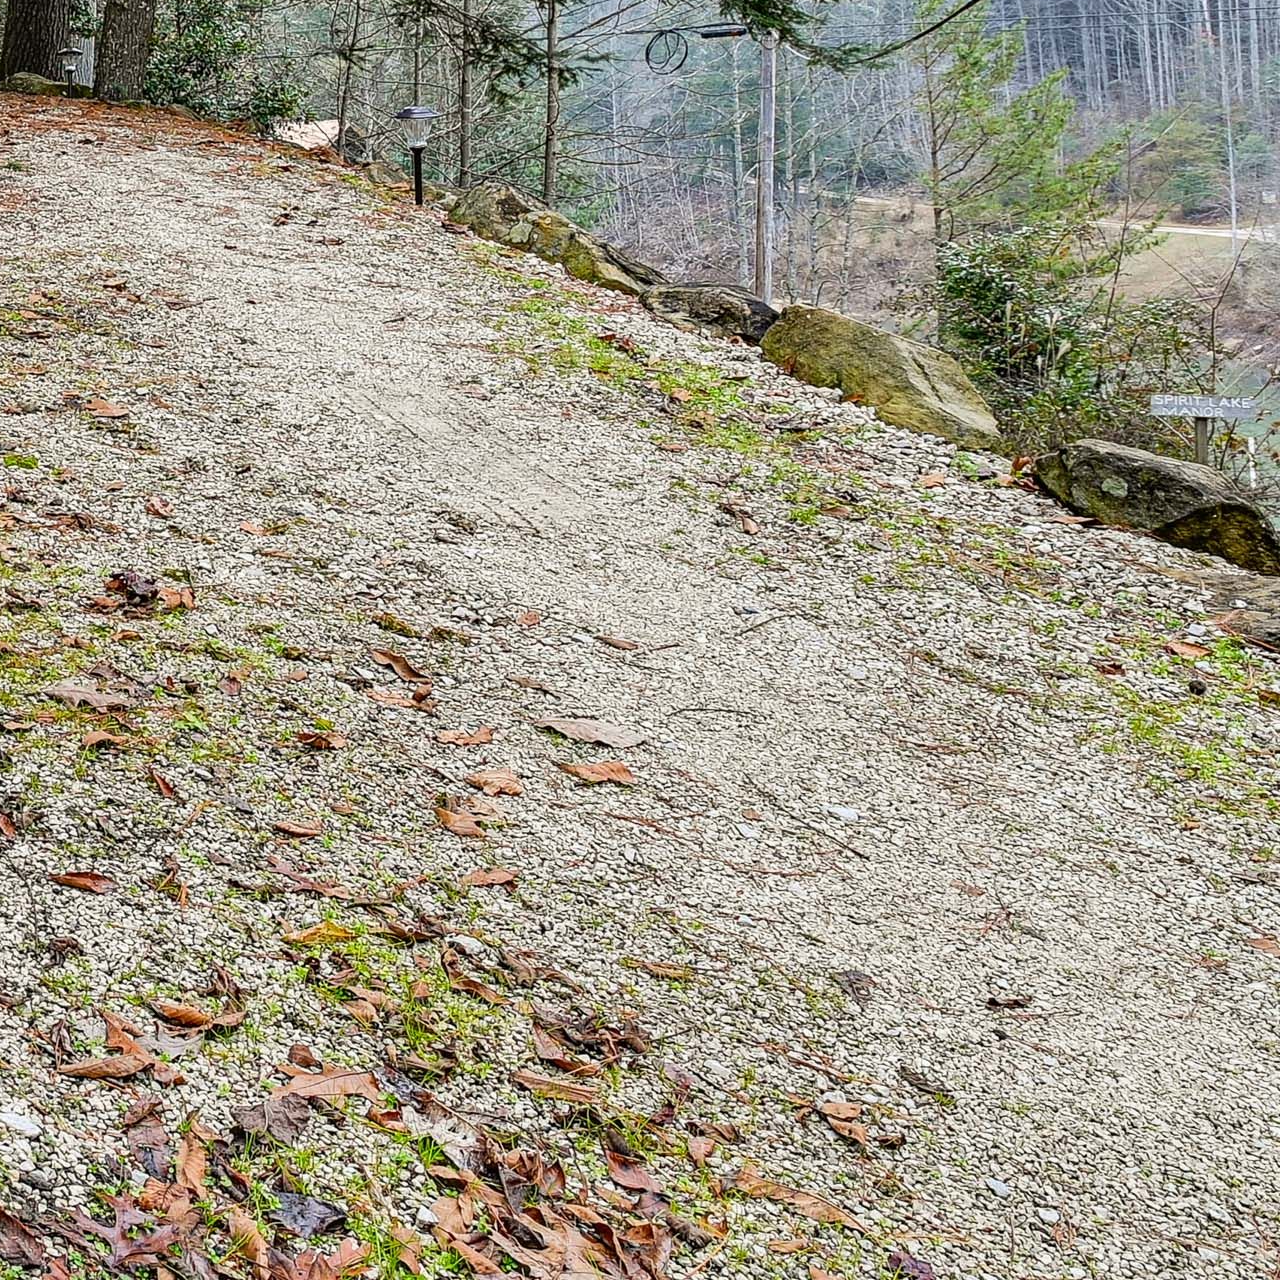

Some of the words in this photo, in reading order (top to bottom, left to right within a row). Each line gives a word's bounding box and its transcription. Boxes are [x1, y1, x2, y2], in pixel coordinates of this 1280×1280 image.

[1154, 394, 1203, 405] SPIRIT
[1208, 397, 1251, 408] LAKE
[1161, 407, 1225, 417] MANOR
